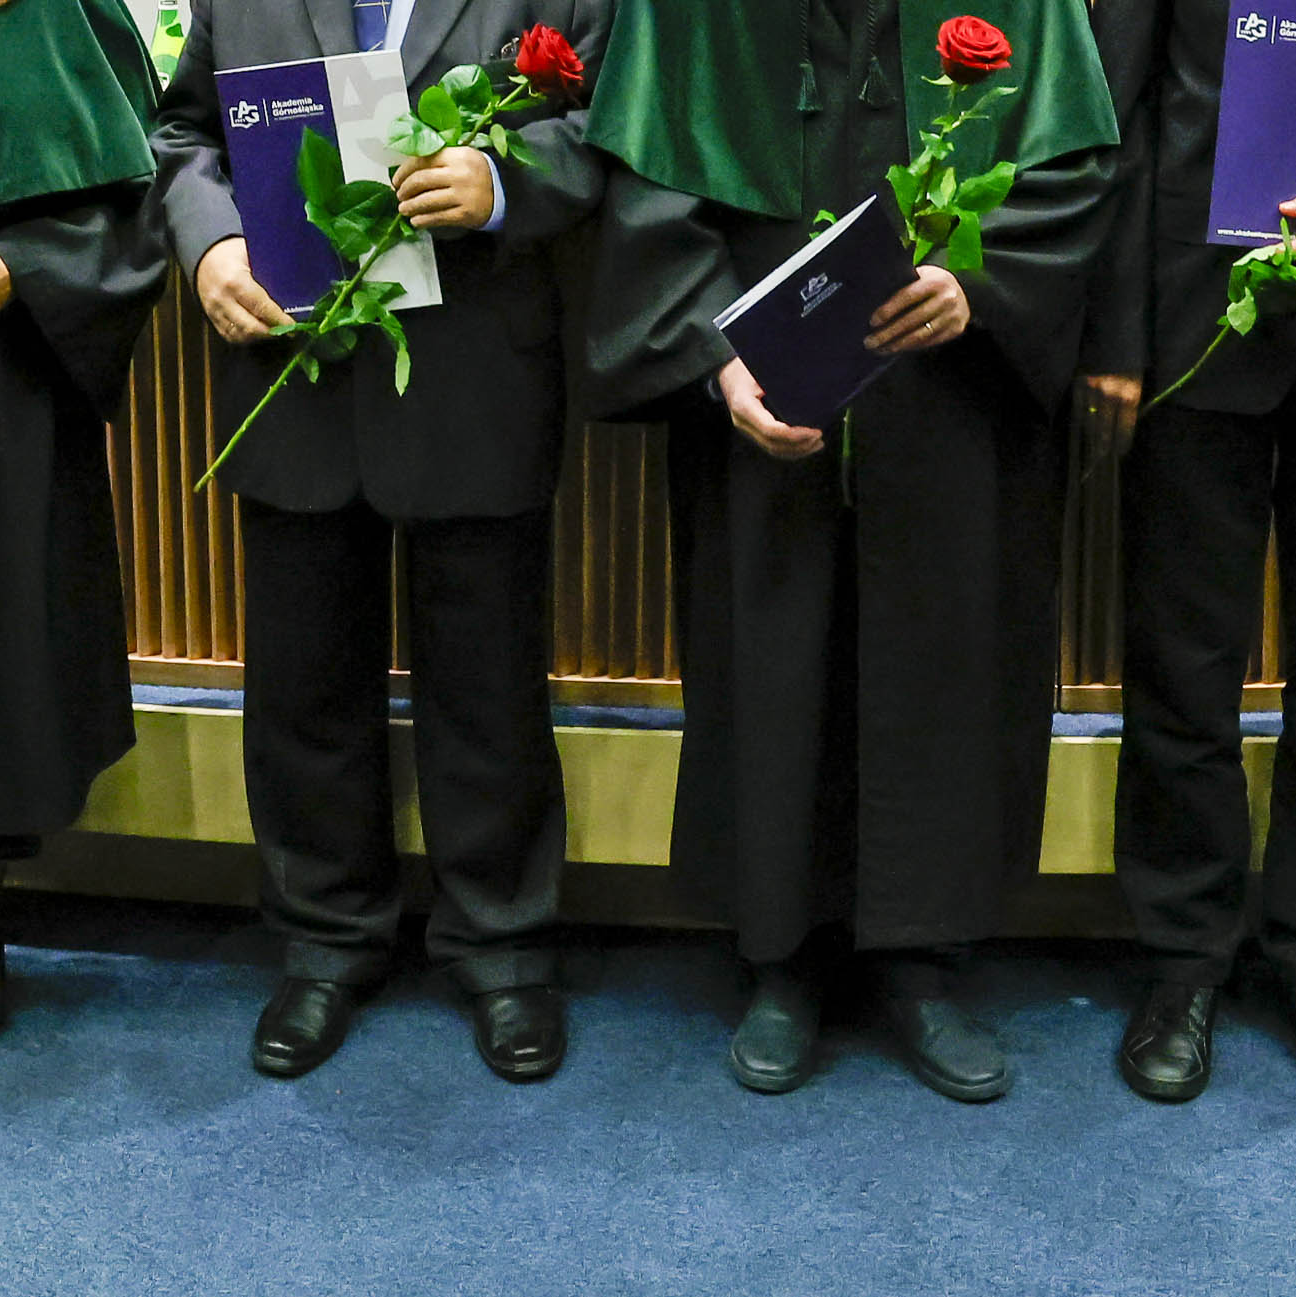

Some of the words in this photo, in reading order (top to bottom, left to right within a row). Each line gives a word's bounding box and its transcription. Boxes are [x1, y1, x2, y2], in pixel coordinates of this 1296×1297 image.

[1244, 13, 1267, 38] AG
[238, 100, 260, 123] AG
[272, 97, 313, 109] Akademia
